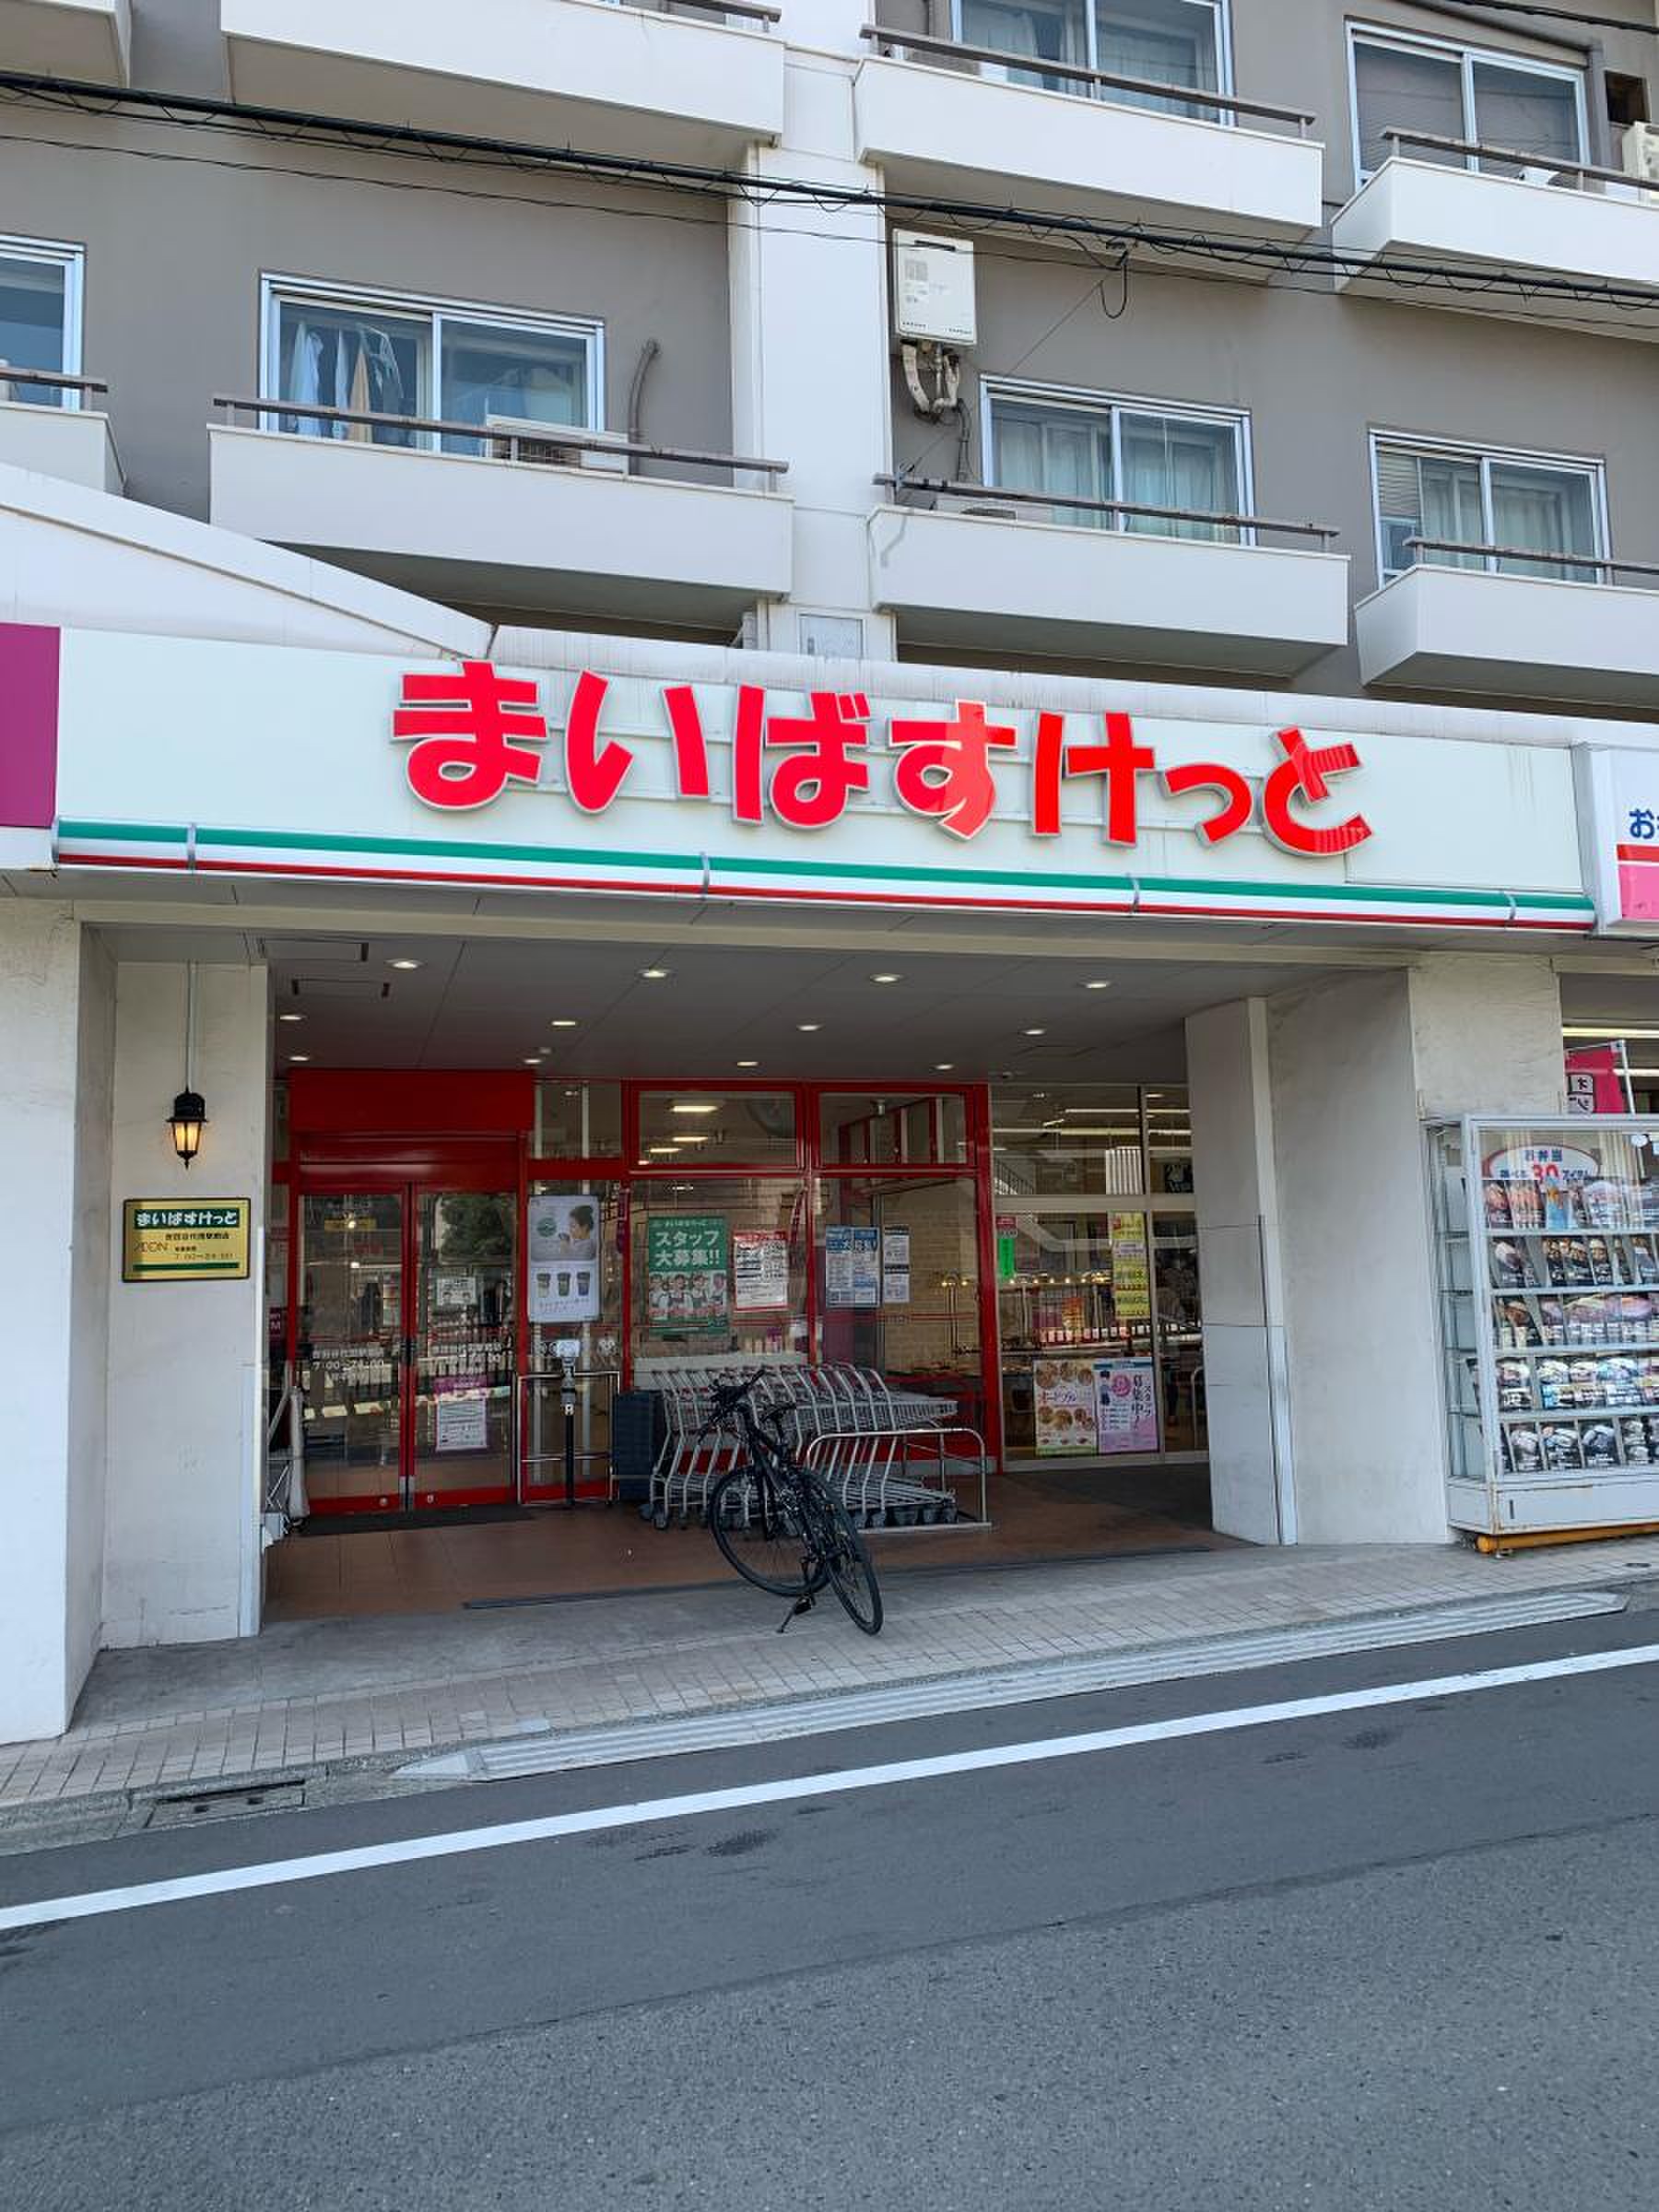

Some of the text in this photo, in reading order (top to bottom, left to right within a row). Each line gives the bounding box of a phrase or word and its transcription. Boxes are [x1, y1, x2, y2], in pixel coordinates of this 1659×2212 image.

[392, 658, 1373, 859] まいばすけっと
[1629, 807, 1659, 840] お
[135, 1210, 238, 1227] まいばすけっと
[655, 1230, 720, 1248] スタッフ
[654, 1249, 720, 1267] 大募集!!
